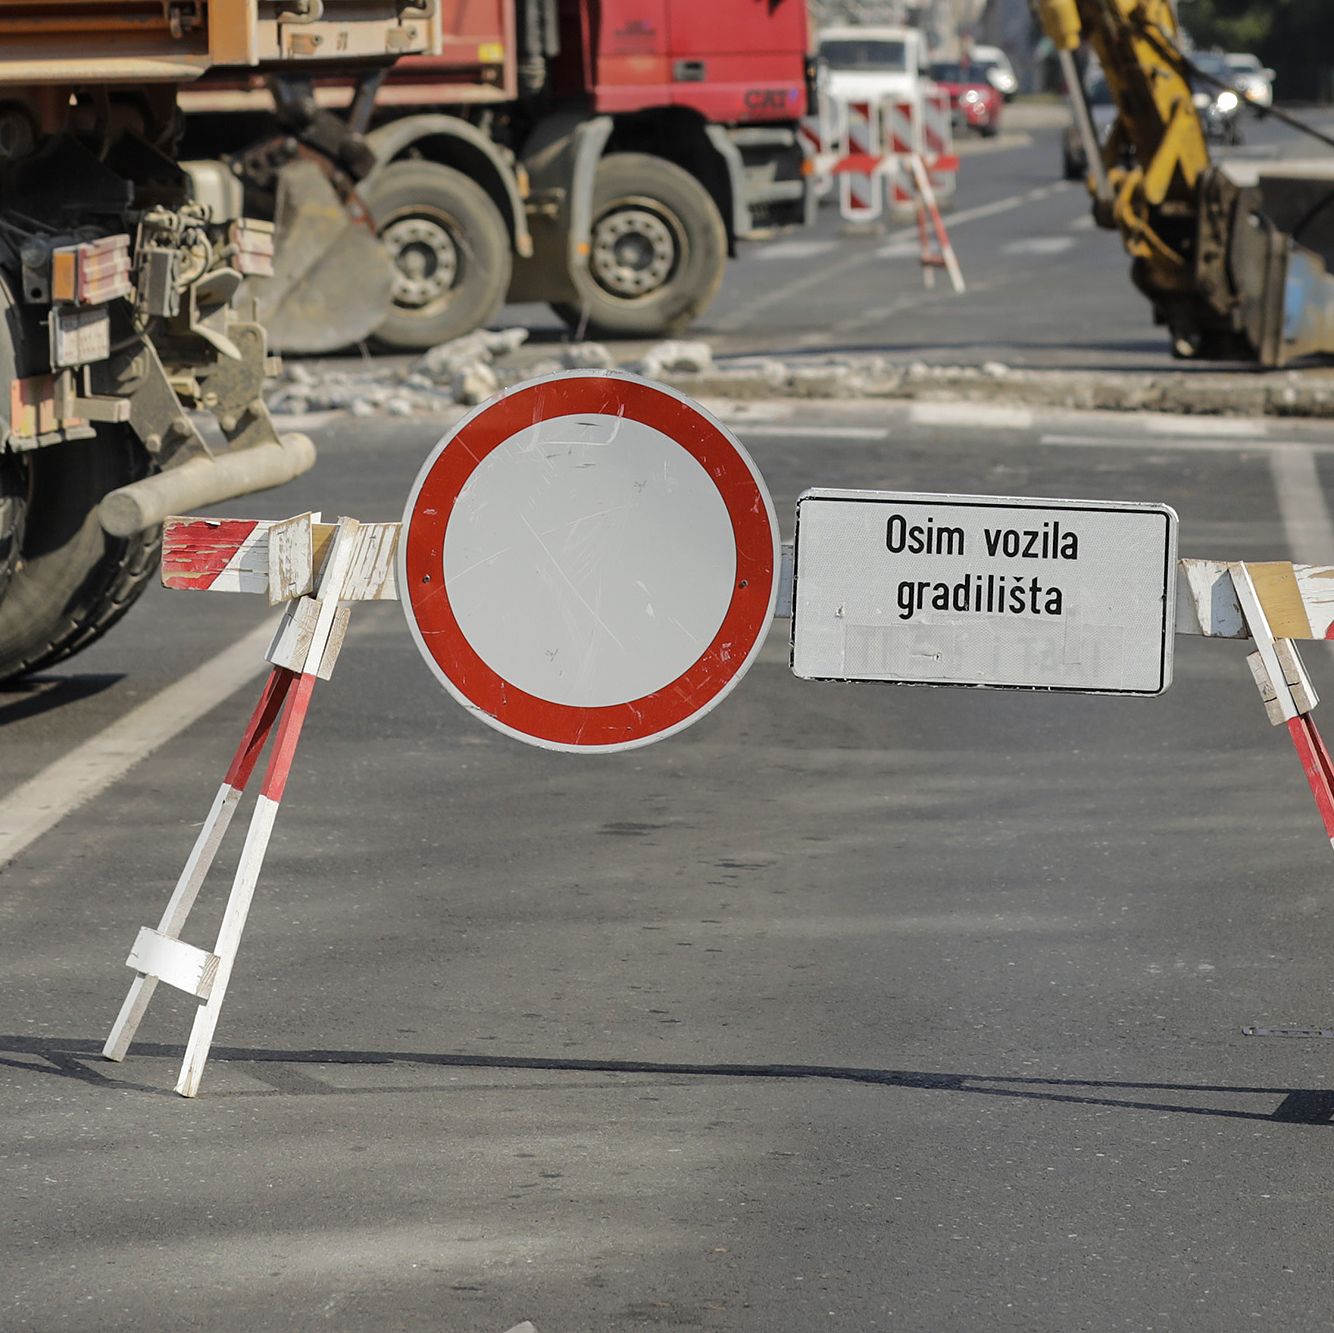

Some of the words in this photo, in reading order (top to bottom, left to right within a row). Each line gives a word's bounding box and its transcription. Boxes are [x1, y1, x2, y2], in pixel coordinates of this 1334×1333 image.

[886, 515, 964, 555] Osim
[984, 522, 1078, 559] vozila
[898, 574, 1062, 619] gradilišta
